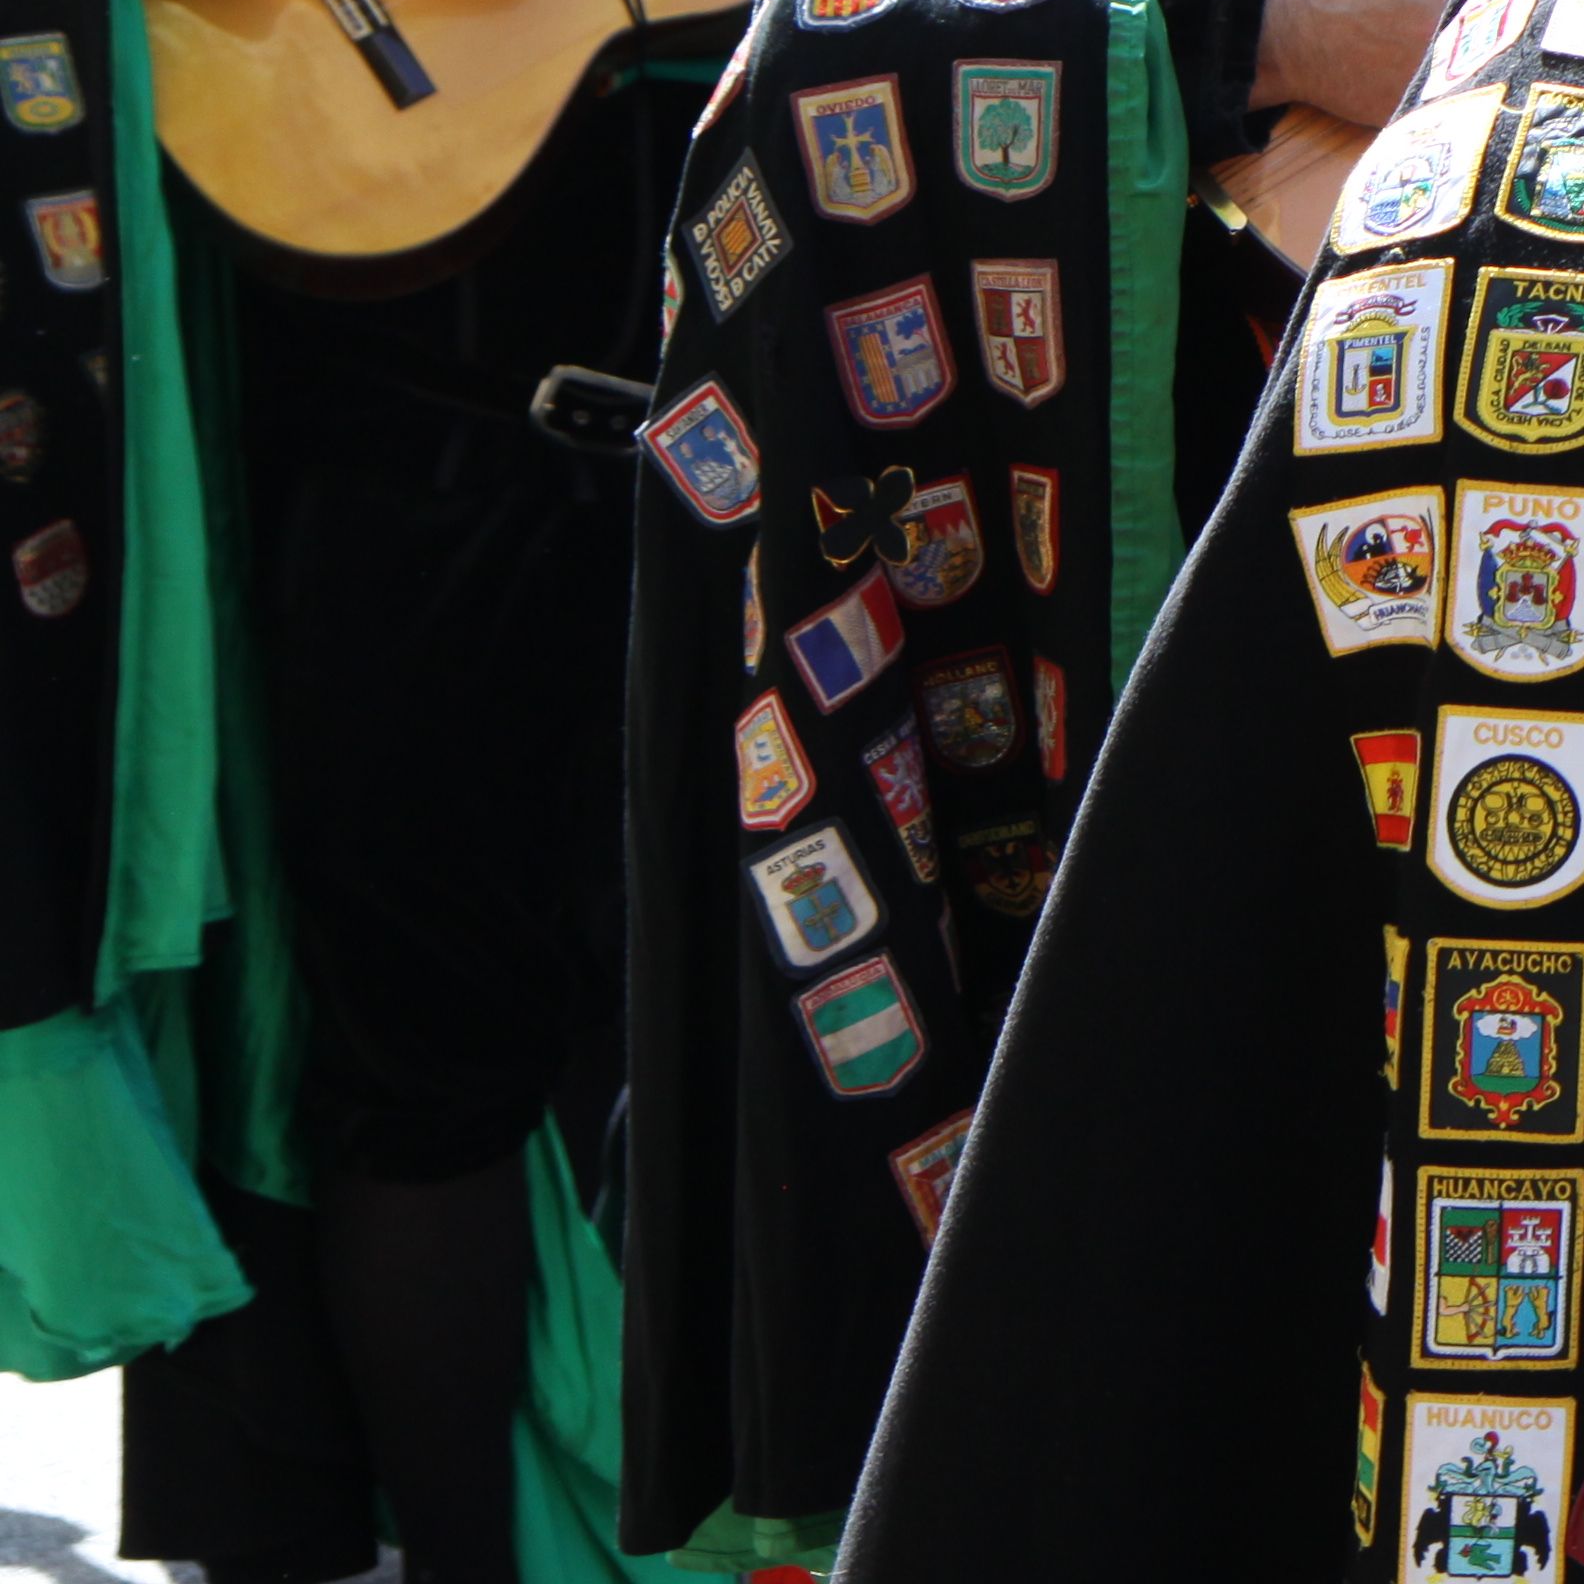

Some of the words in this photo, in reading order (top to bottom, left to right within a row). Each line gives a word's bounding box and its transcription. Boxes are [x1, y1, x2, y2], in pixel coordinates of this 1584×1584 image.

[815, 95, 877, 115] OVIEDO
[1343, 333, 1398, 350] PIMENTEL
[1493, 338, 1511, 383] CIUDAD
[1543, 341, 1573, 353] SAN
[1473, 721, 1566, 750] CUSCO
[765, 839, 827, 877] ASTURIAS
[1446, 949, 1573, 974] AYACUCHO
[1431, 1177, 1573, 1202] HUANCAYO
[1425, 1406, 1554, 1431] HUANUCO
